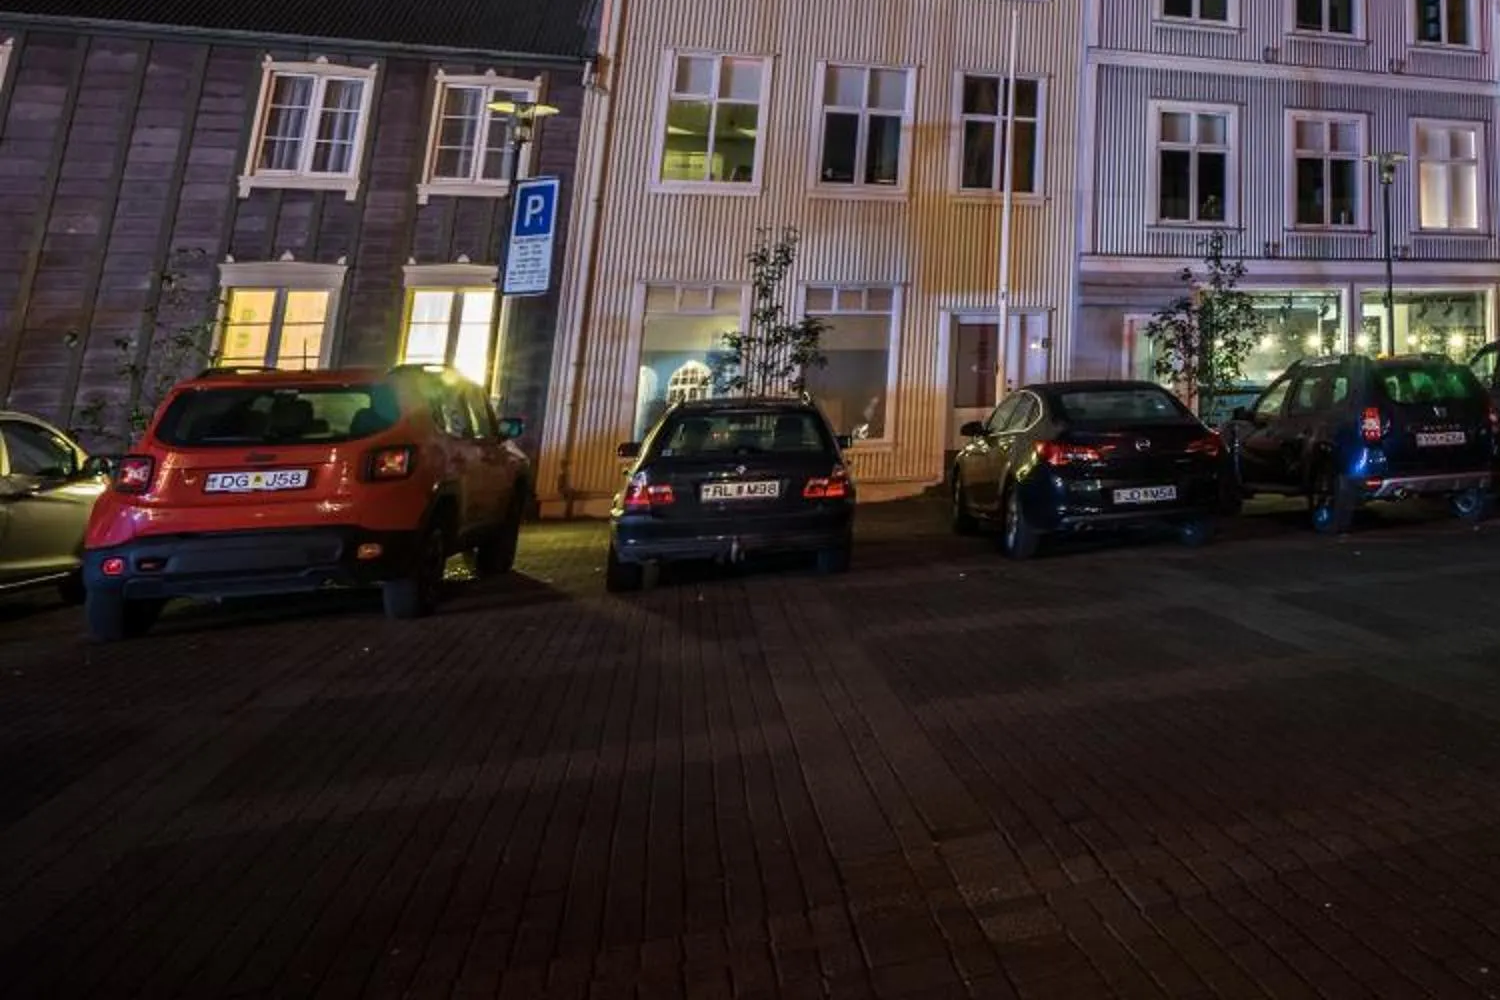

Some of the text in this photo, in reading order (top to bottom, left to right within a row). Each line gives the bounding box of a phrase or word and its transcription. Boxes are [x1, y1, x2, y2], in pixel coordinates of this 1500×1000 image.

[524, 194, 545, 228] P
[219, 472, 301, 489] DG J58
